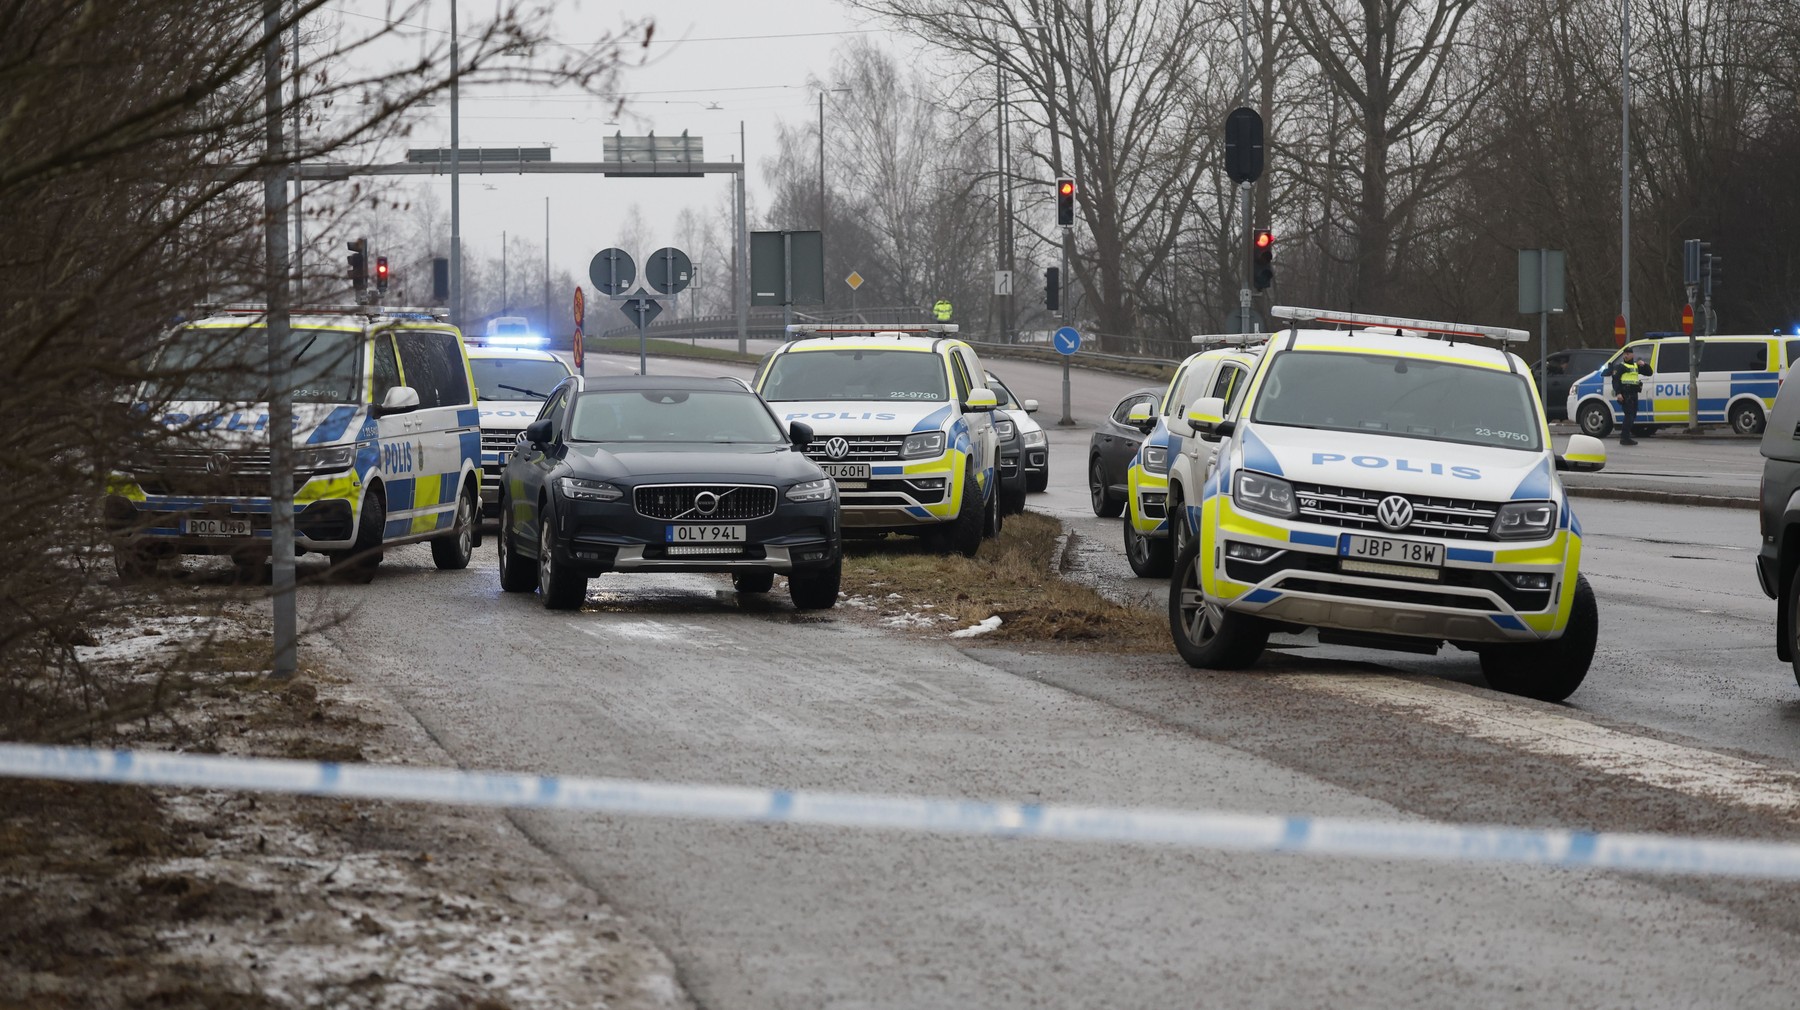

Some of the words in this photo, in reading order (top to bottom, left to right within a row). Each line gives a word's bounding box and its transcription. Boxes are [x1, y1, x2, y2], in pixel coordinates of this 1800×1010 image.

[890, 391, 939, 399] 22-9730
[480, 410, 536, 418] POL
[785, 412, 896, 421] POLIS
[1475, 427, 1529, 442] 23-9750
[384, 441, 412, 474] POLIS
[821, 466, 837, 477] TU
[840, 466, 865, 477] 60H
[1312, 453, 1482, 480] POLIS
[1300, 498, 1317, 507] V6
[678, 527, 707, 540] OLY
[712, 527, 740, 540] 94L
[1357, 538, 1393, 557] JBP
[1402, 543, 1436, 562] 18W
